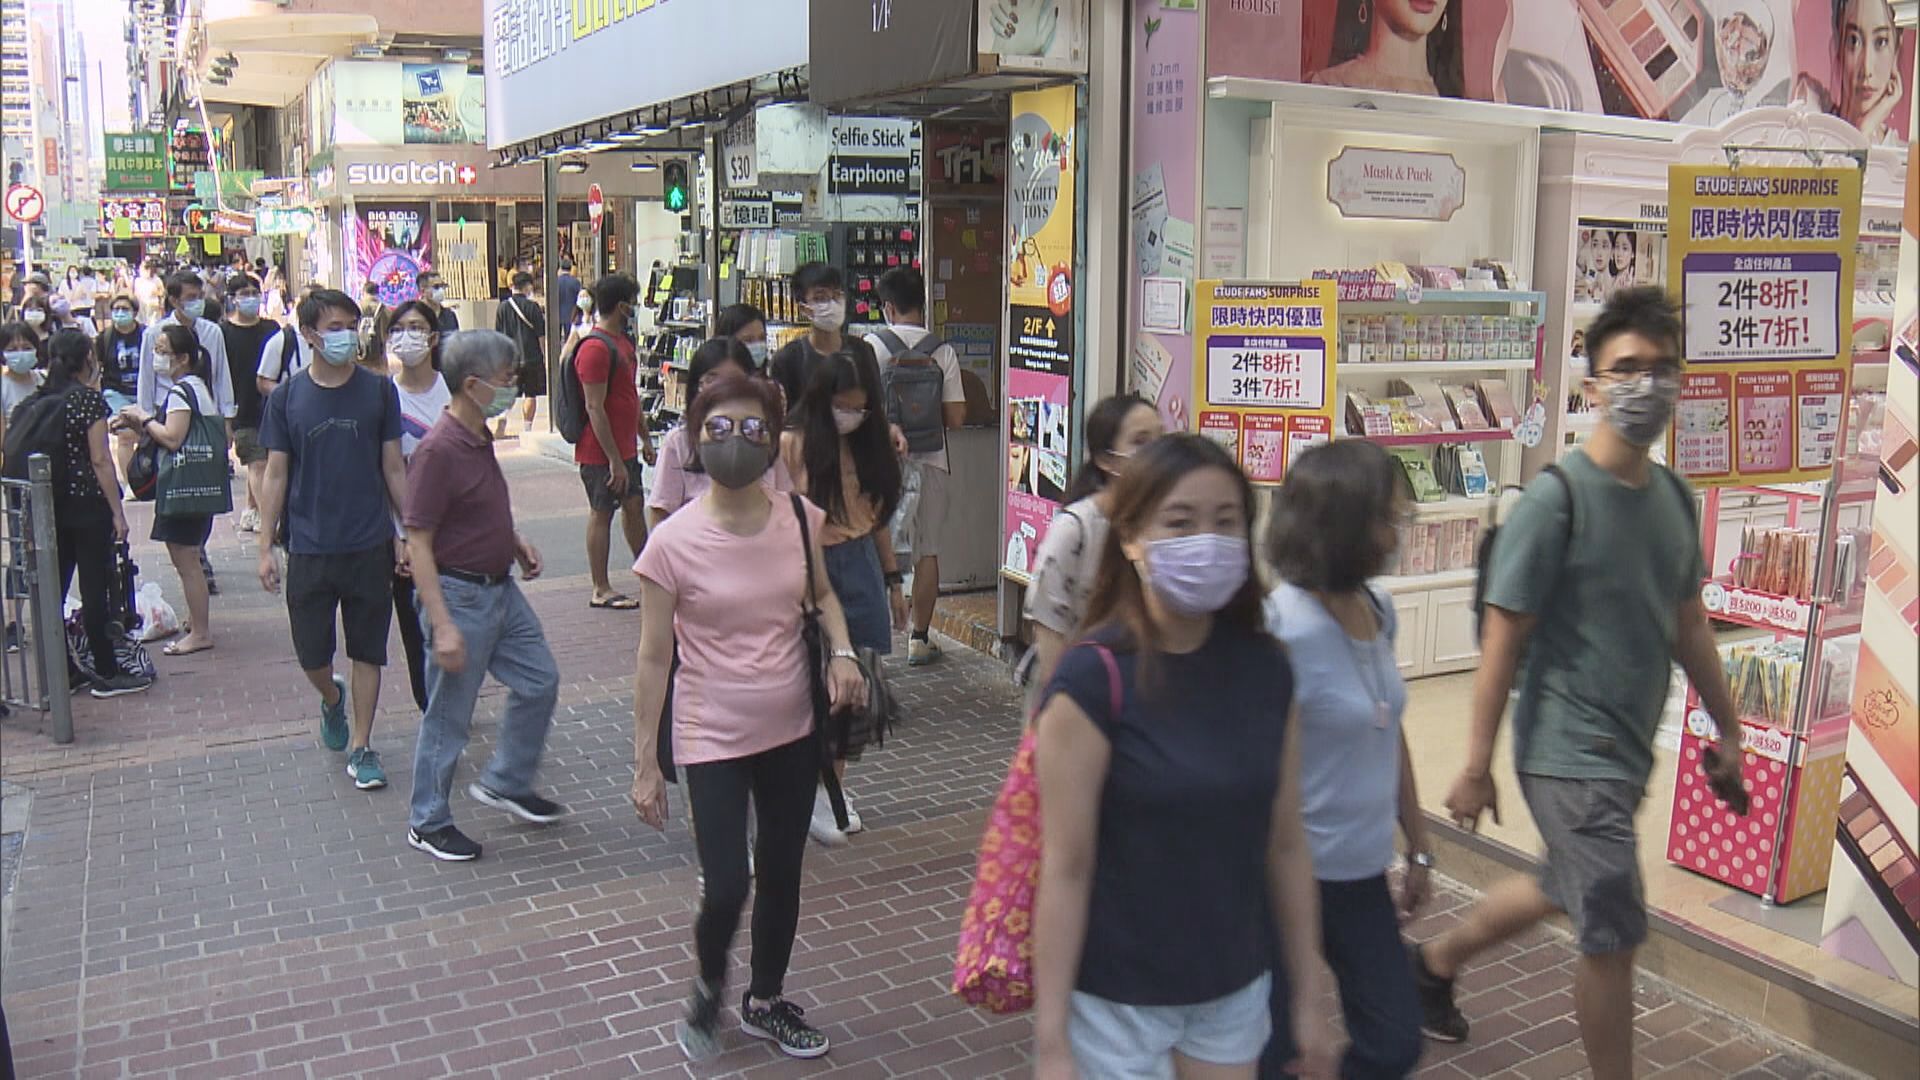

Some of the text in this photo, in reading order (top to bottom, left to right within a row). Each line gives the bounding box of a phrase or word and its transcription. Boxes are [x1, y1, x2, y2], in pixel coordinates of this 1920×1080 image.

[1230, 0, 1281, 16] HOUSE
[1150, 63, 1180, 77] 0.2mm
[832, 127, 905, 148] Selfie Stick
[347, 160, 456, 185] swatch
[731, 155, 750, 184] $30
[832, 162, 906, 188] Earphone
[1362, 163, 1433, 183] Mask & Pack
[1013, 187, 1058, 203] NAUGHTY
[1695, 176, 1839, 196] ETUDE FANS SURPRISE
[368, 211, 419, 221] BIG BOLD
[1024, 204, 1049, 220] TOYS
[1691, 207, 1841, 240] 限時快閃優惠
[1213, 287, 1320, 300] ETUDE FANS SURPRISE
[1718, 278, 1809, 311] 2件8折!
[1023, 316, 1043, 336] 2/F
[1211, 306, 1323, 328] 限時快閃優惠
[1718, 316, 1810, 349] 3件7折!
[1231, 352, 1301, 373] 2件8折!
[1231, 377, 1301, 398] 3件7折!
